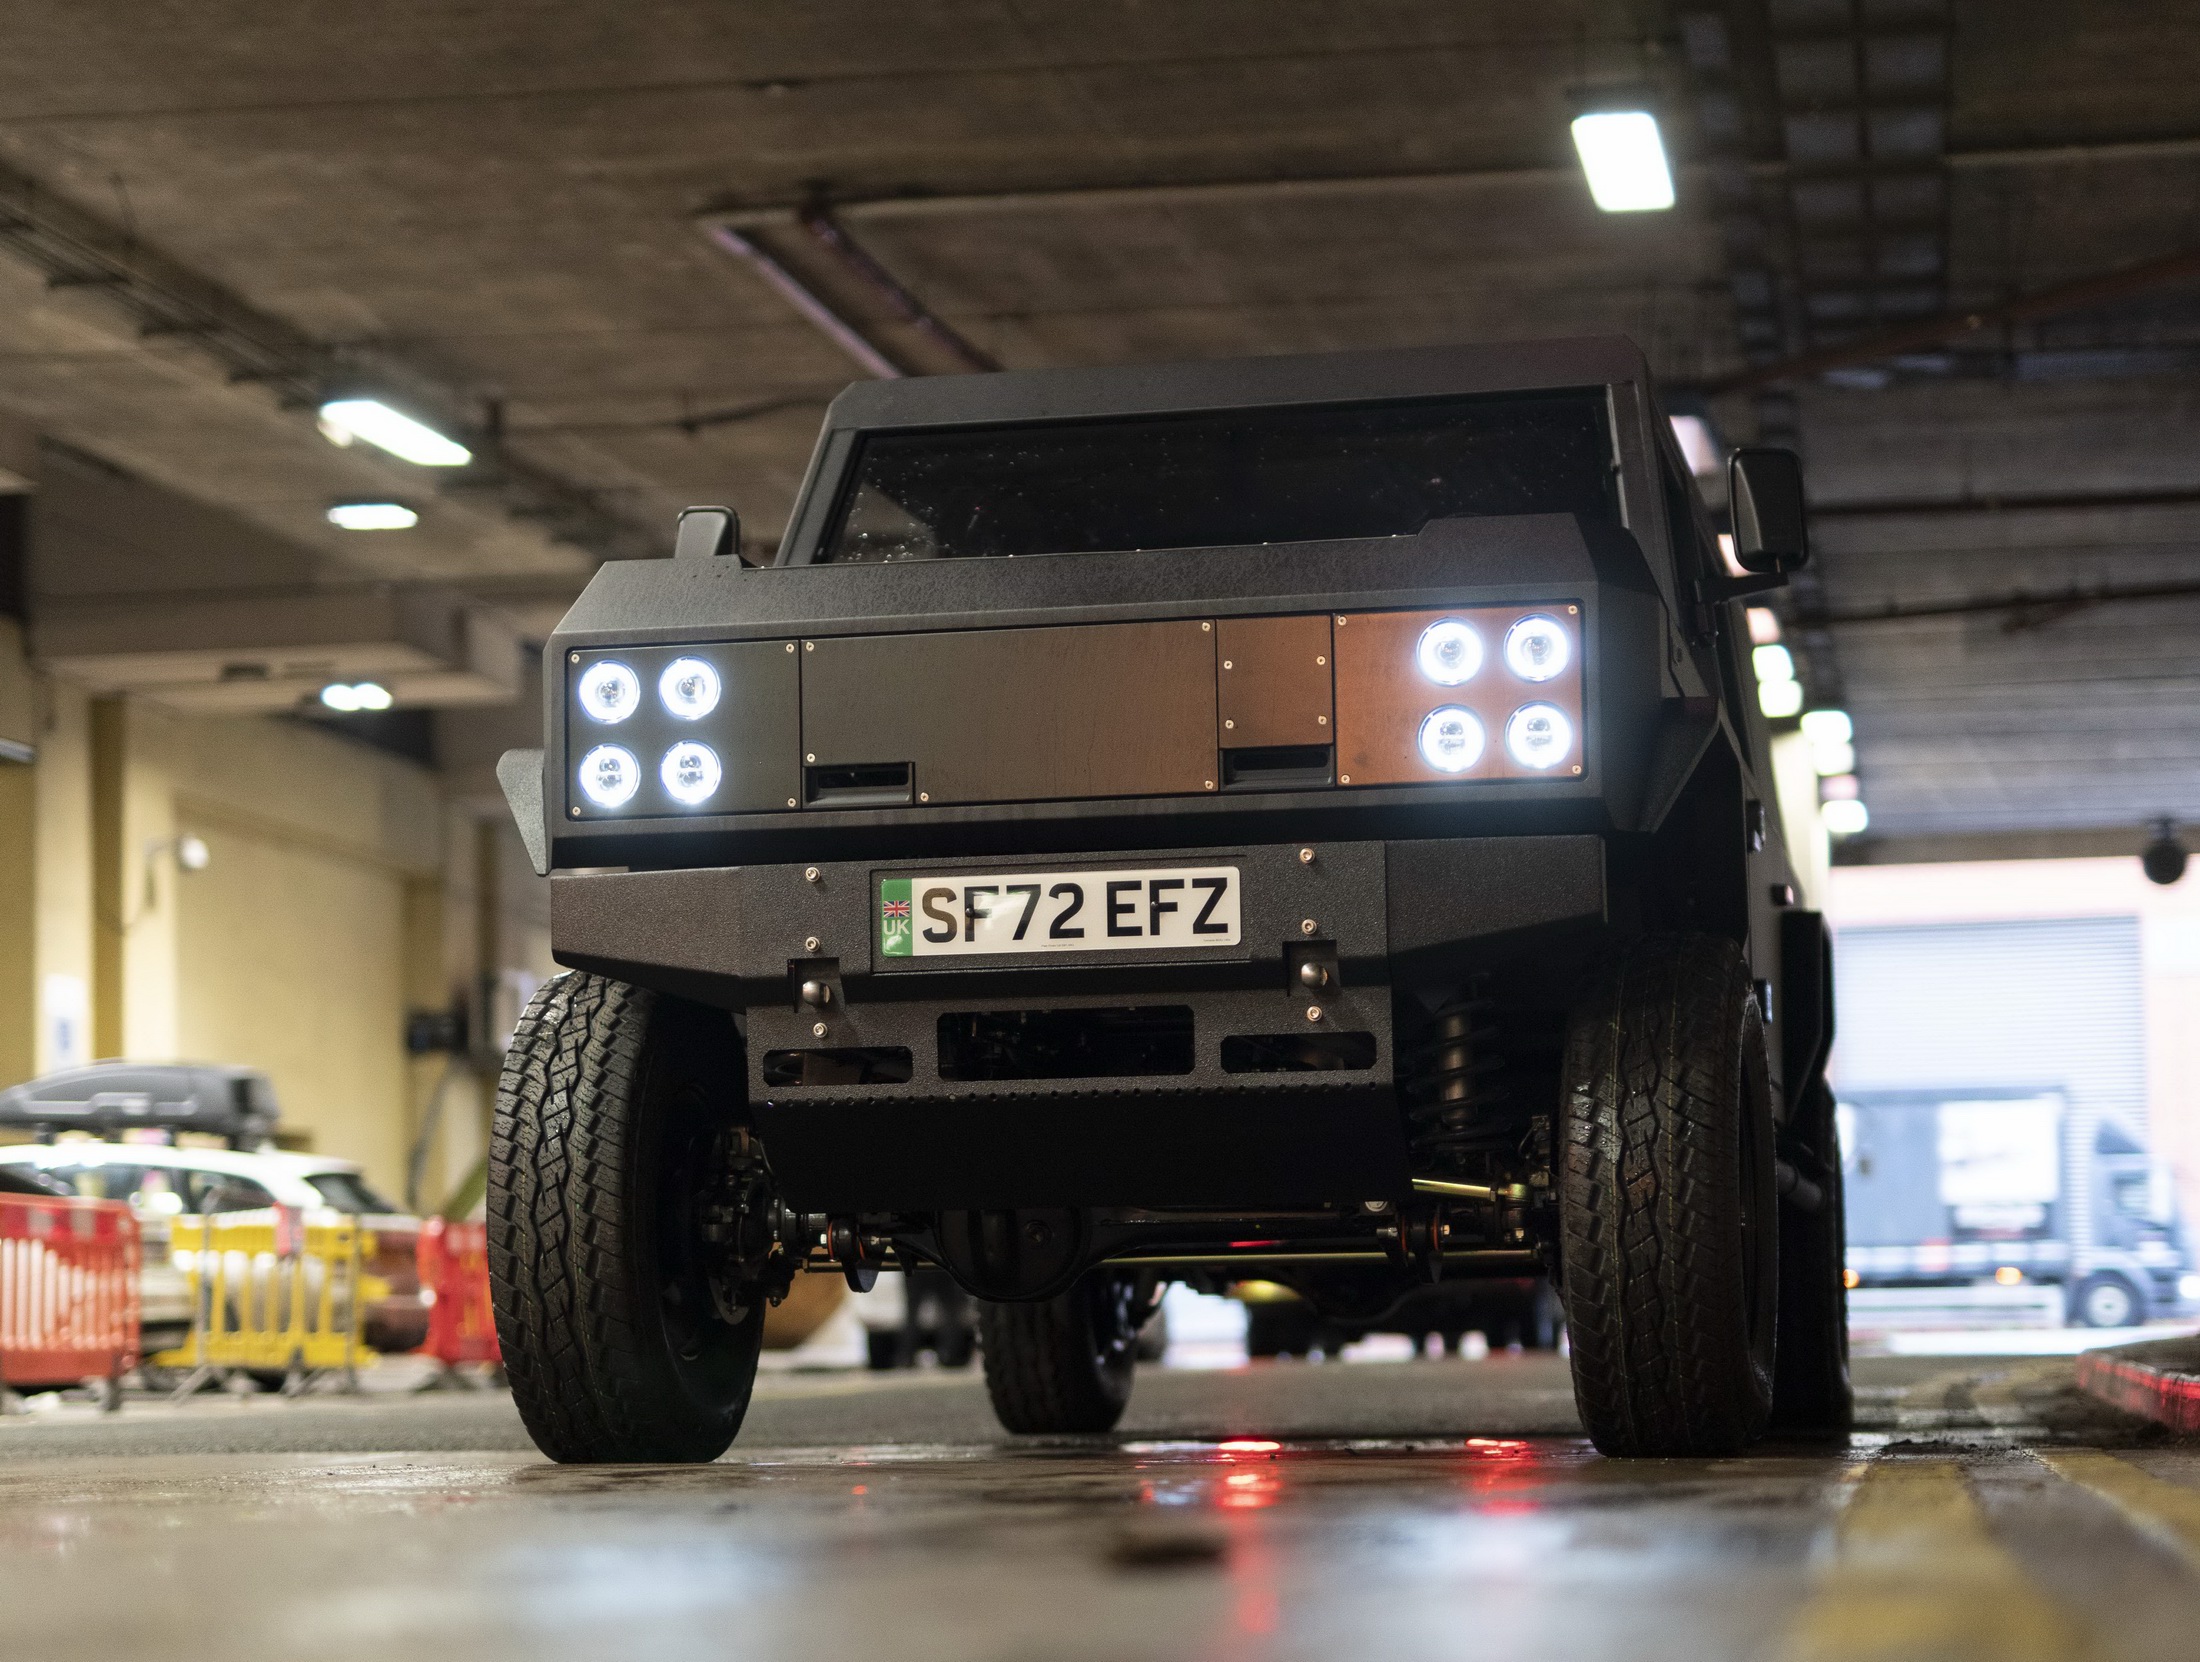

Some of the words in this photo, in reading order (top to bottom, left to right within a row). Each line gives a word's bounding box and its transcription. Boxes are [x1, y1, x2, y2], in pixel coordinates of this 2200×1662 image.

[883, 919, 910, 936] UK
[922, 883, 1085, 944] SF72
[1106, 877, 1229, 938] EFZ
